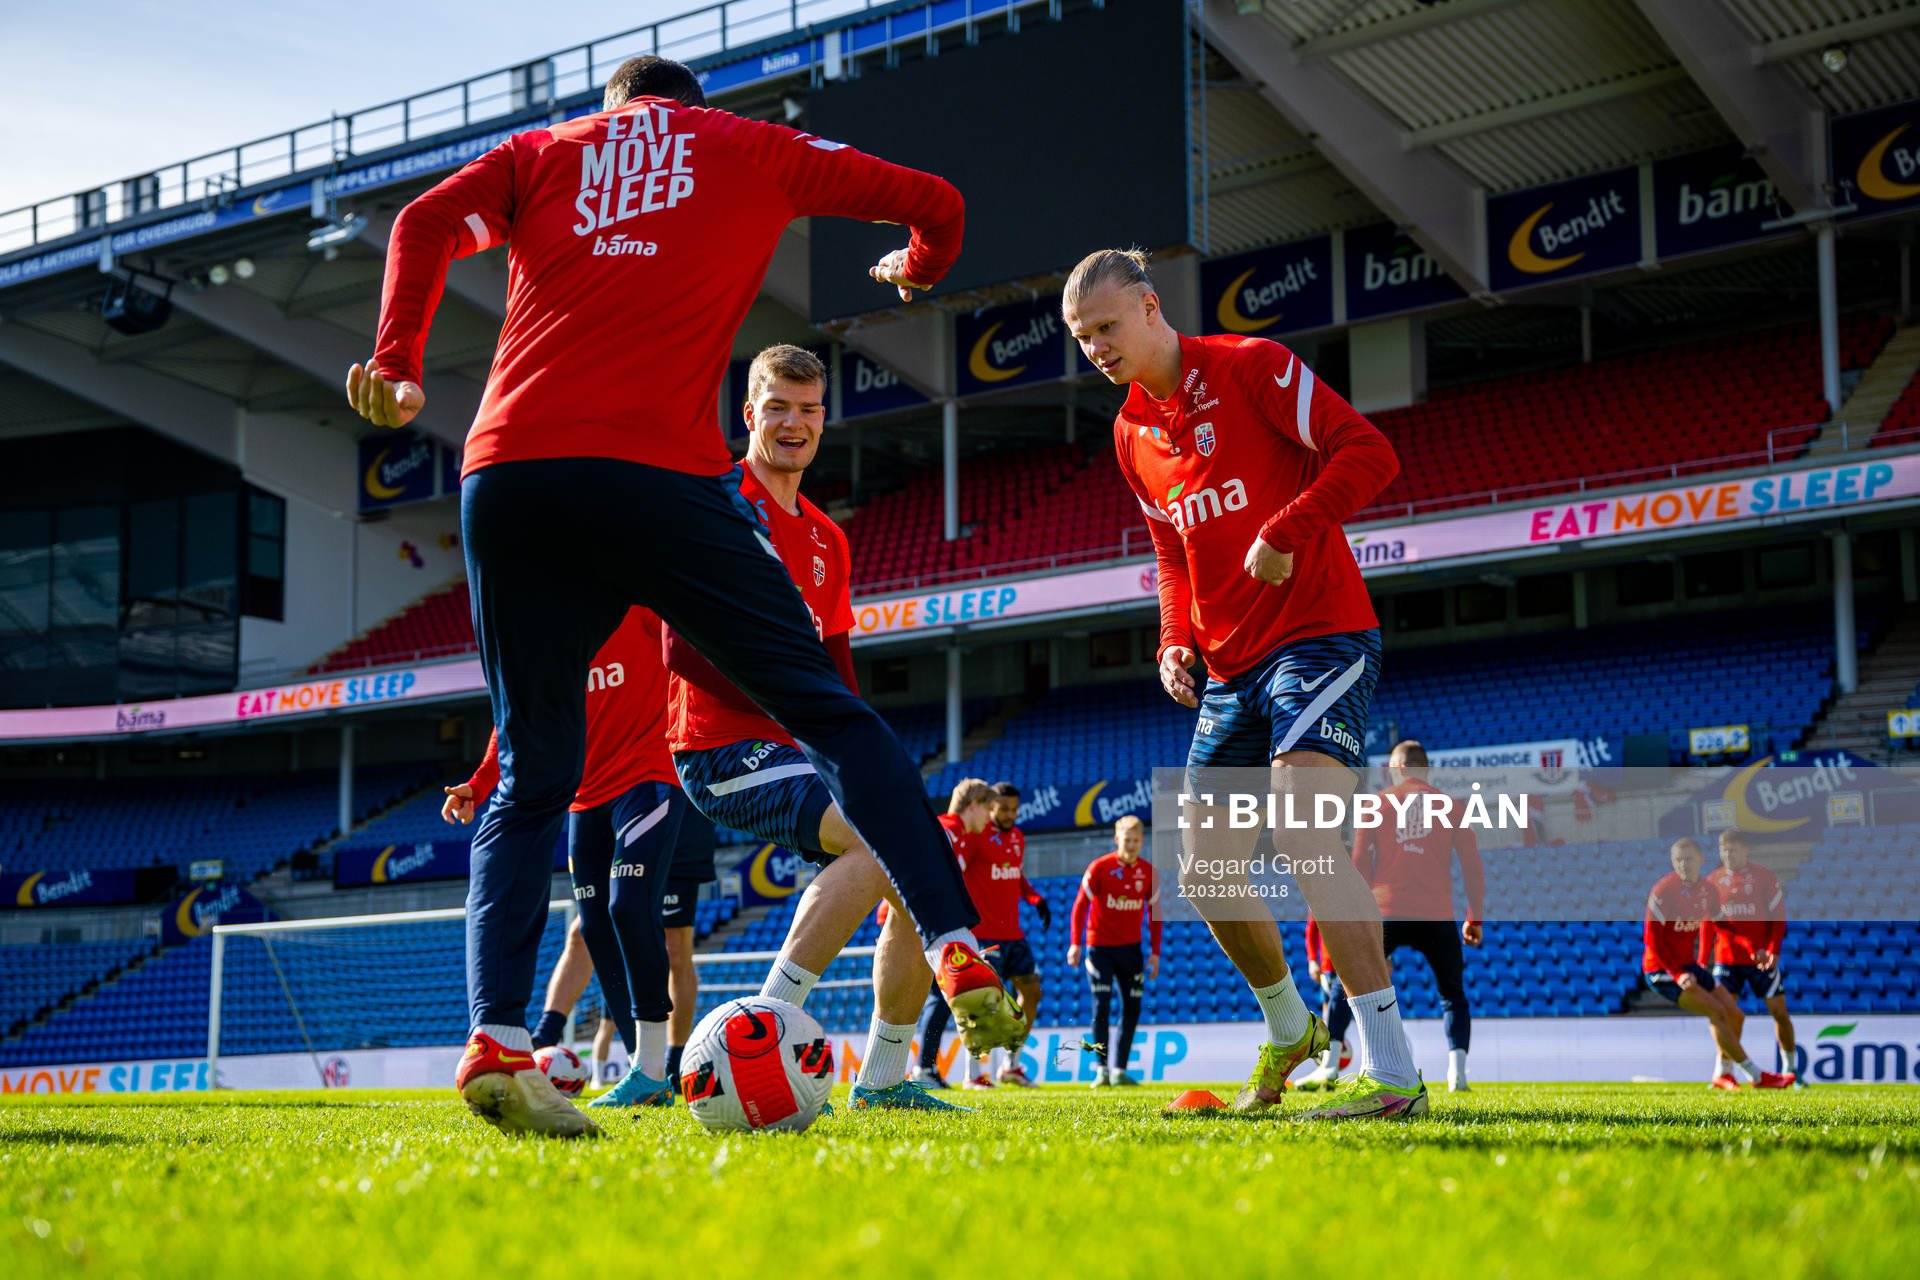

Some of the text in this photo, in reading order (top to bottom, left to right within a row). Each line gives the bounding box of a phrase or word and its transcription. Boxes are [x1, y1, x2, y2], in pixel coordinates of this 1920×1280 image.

[606, 103, 675, 142] EAT
[580, 133, 696, 192] MOVE
[572, 169, 695, 237] SLEEP
[1678, 179, 1774, 226] bam
[1363, 252, 1449, 291] bam
[1155, 478, 1249, 532] ama
[1353, 463, 1895, 563] ama EAT MOVE SLEEP
[852, 600, 918, 634] OVE
[924, 586, 1017, 626] SLEEP
[237, 690, 277, 720] EAT
[278, 682, 344, 712] MOVE
[347, 671, 416, 702] SLEEP
[1475, 751, 1533, 767] NORGE
[609, 863, 645, 879] ama
[992, 863, 1021, 880] bam
